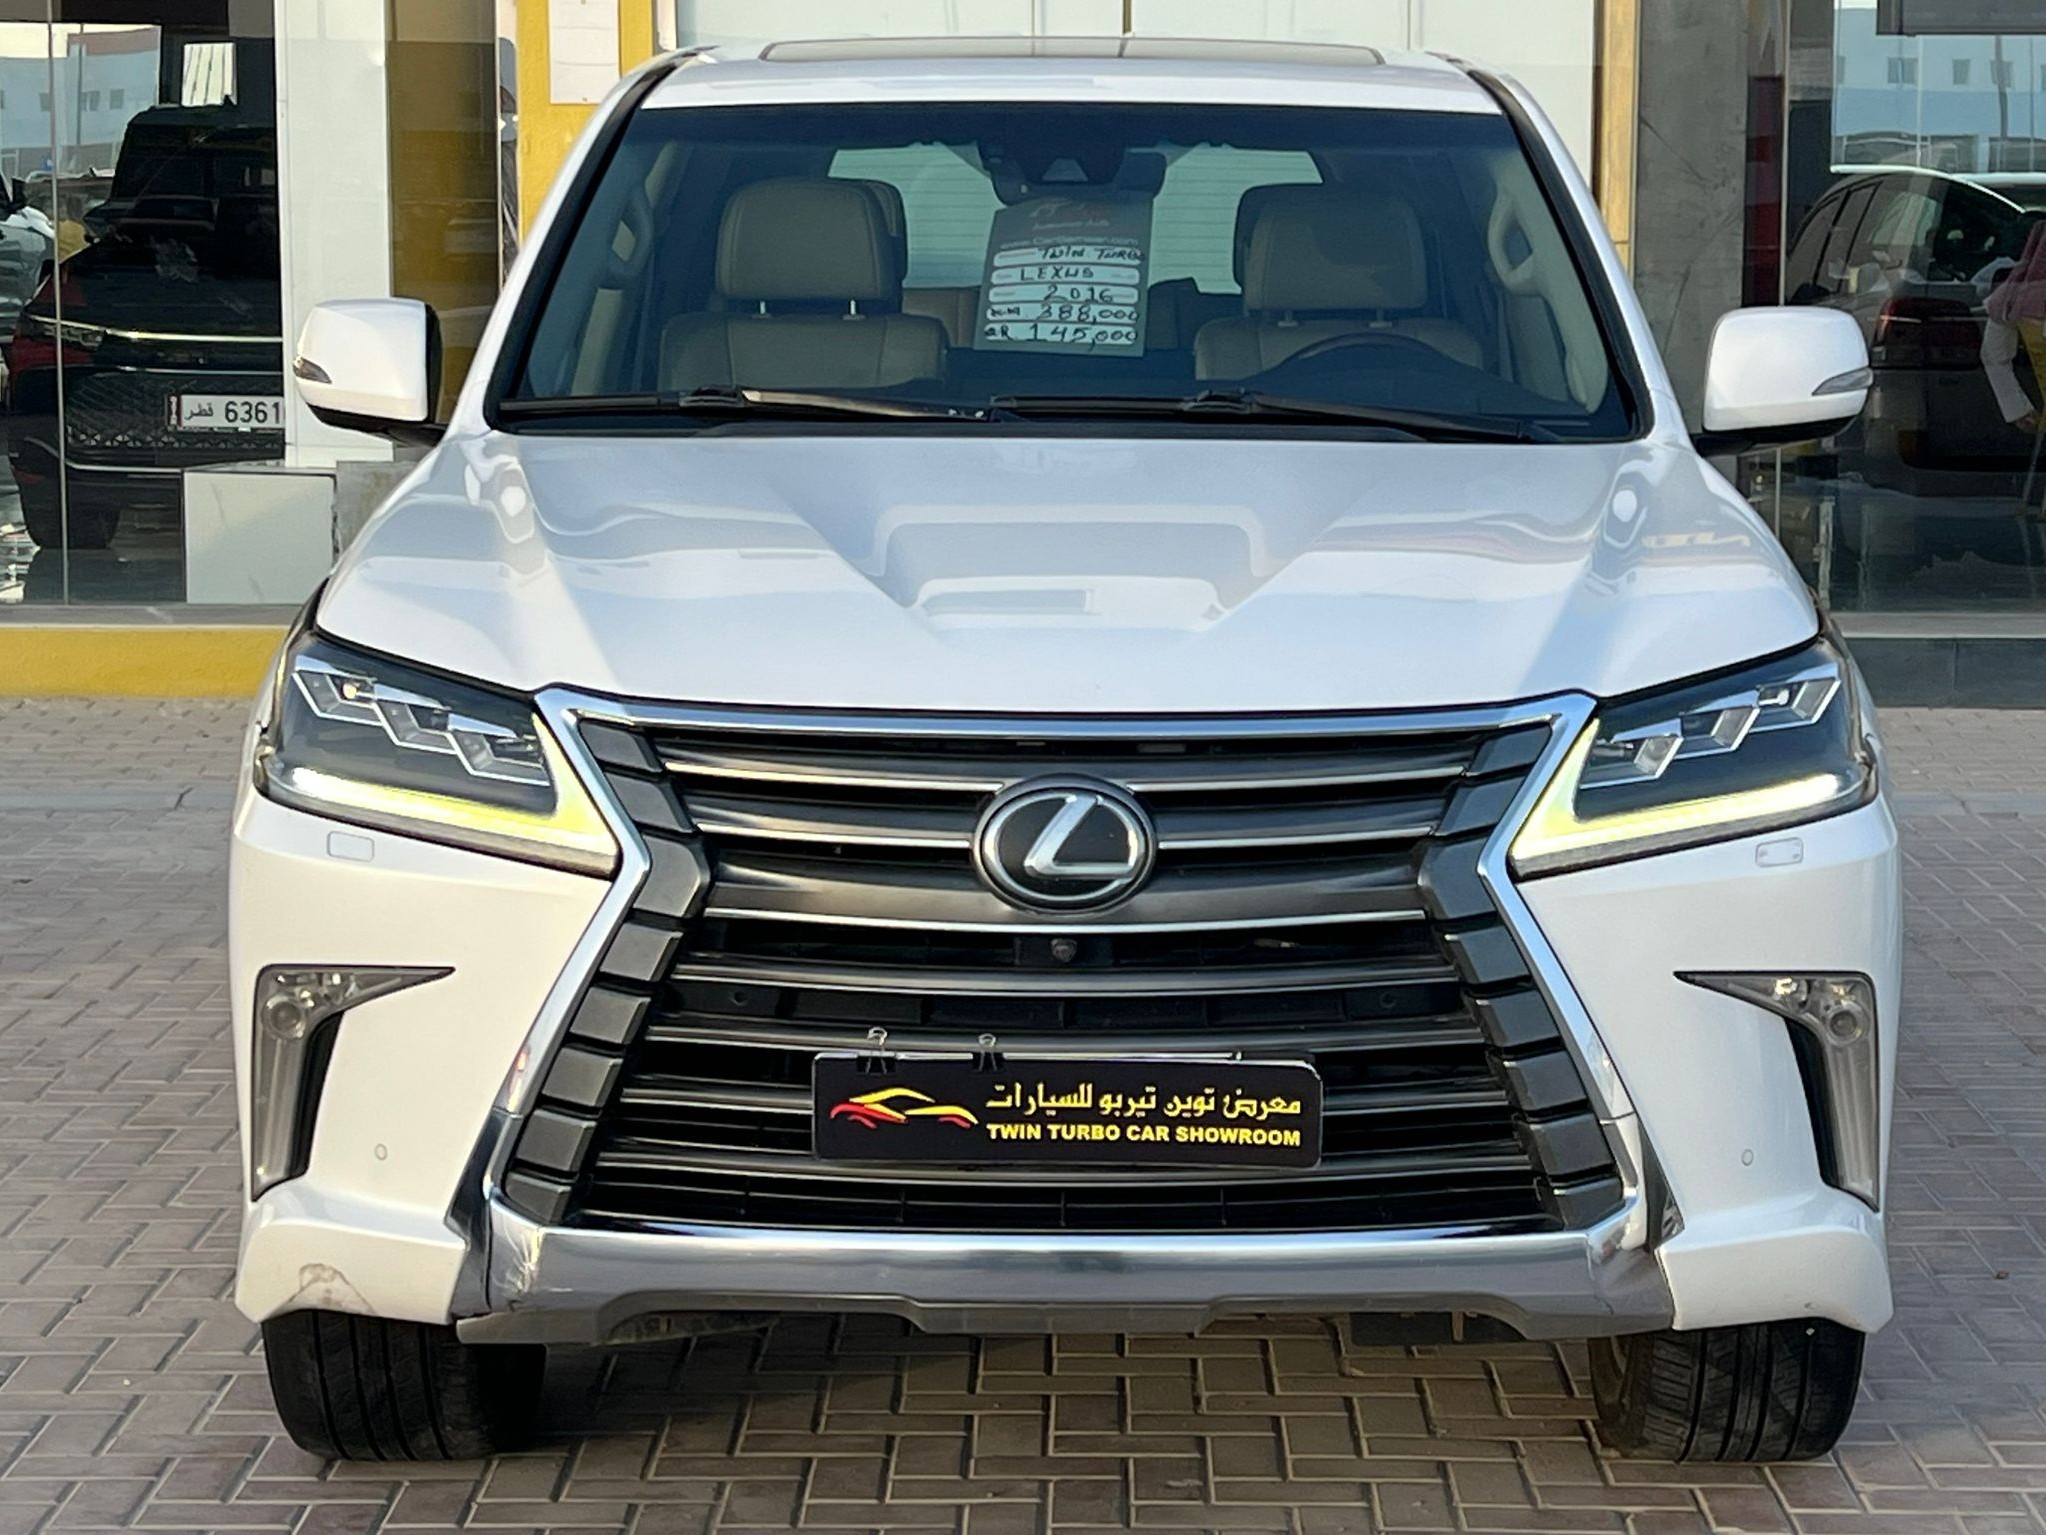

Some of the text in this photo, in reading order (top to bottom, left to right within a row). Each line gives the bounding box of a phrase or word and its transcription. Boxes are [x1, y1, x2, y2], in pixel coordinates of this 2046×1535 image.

[1021, 266, 1094, 281] LEXUS
[1044, 284, 1114, 303] 2016
[1025, 323, 1138, 351] 145,000
[183, 402, 214, 421] قطر
[985, 1081, 1301, 1121] معرض توين تيربو للسيارات
[986, 1123, 1301, 1147] TWIN TURBO CAR SHOWROOM
